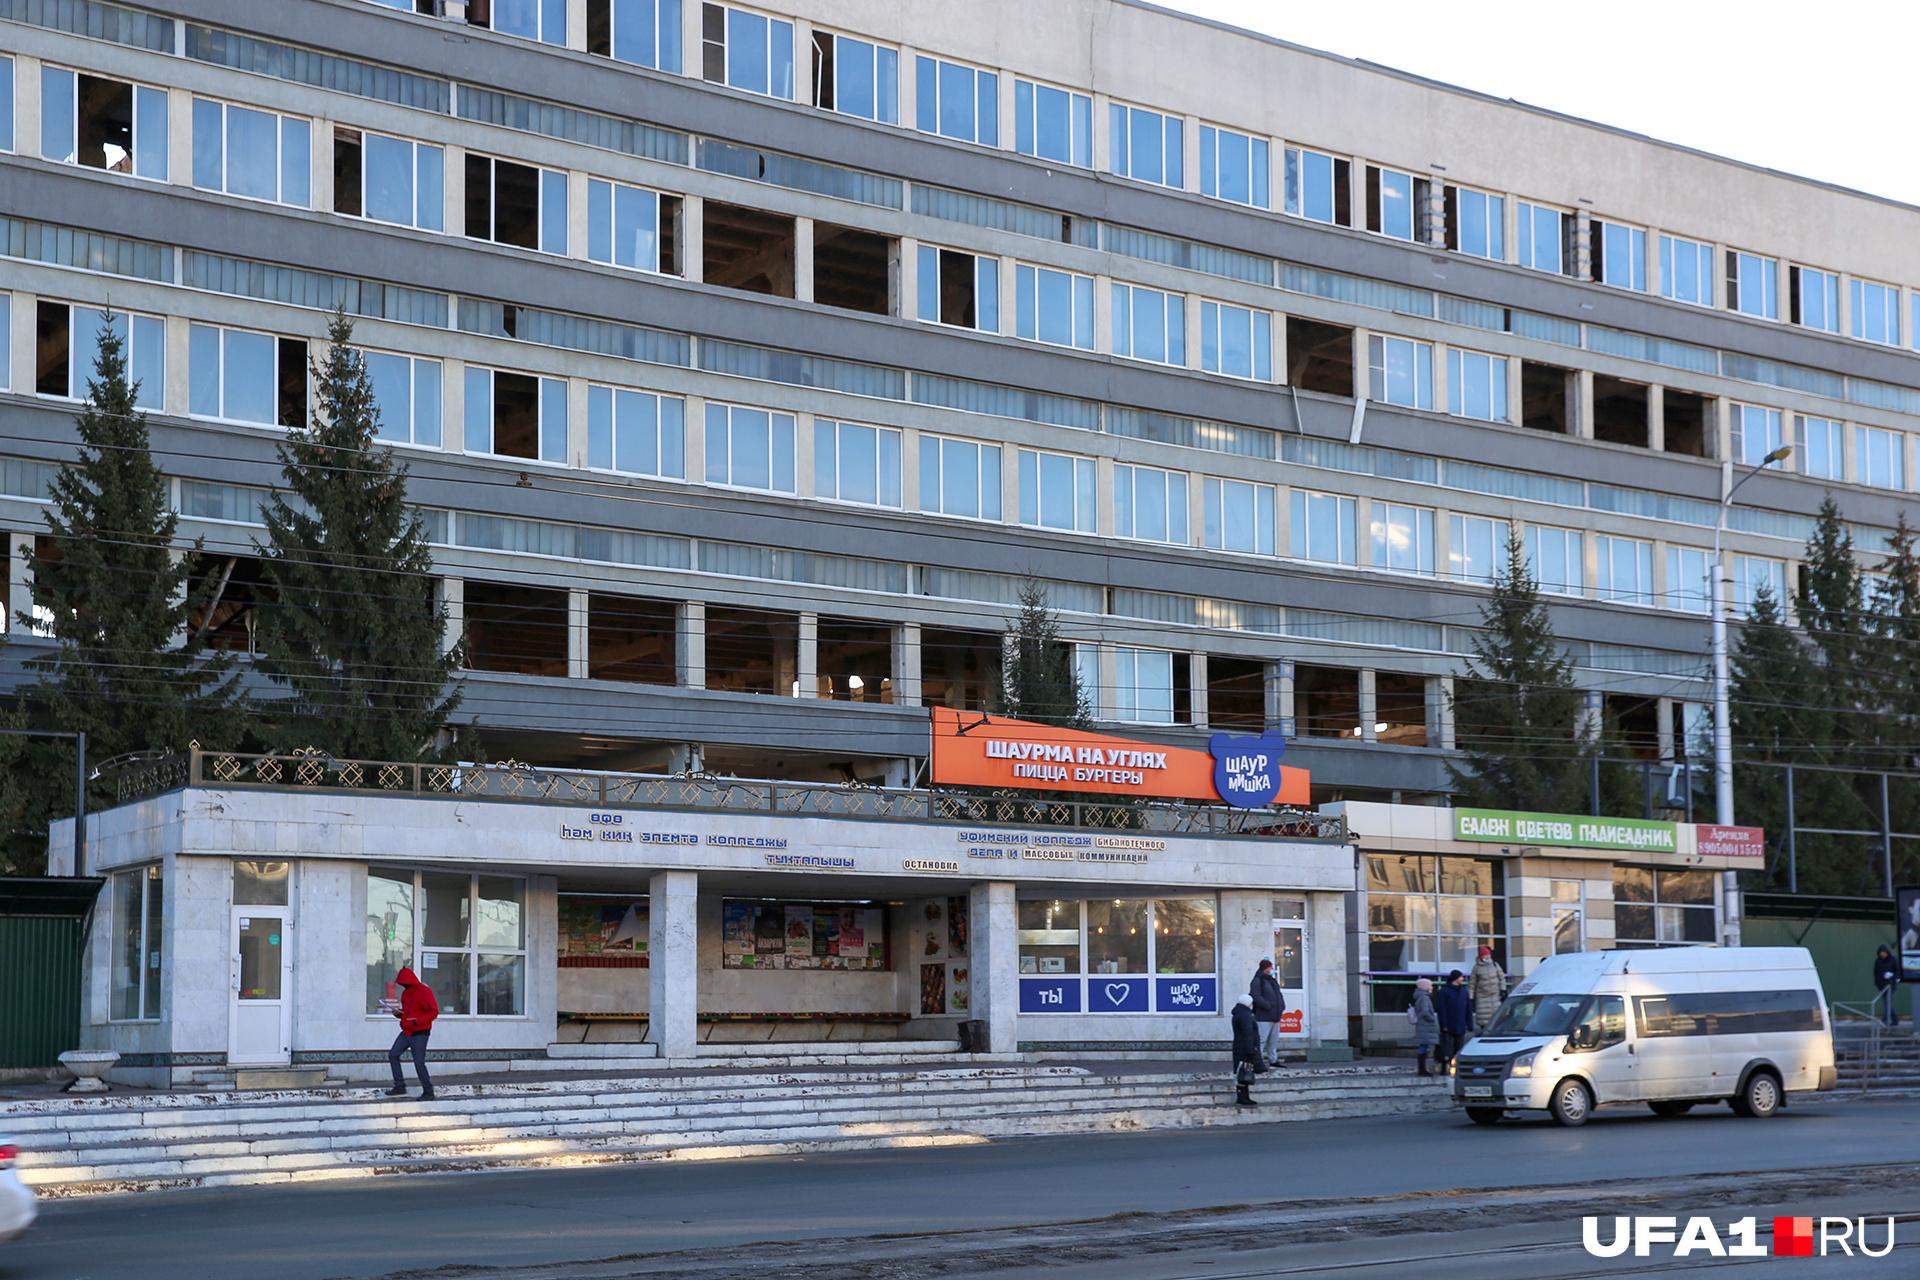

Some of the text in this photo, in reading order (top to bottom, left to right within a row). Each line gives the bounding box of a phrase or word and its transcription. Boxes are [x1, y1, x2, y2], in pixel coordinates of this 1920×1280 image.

[986, 740, 1167, 771] ШАУРМА НА УГЛЯХ
[1226, 754, 1267, 776] ШАУР
[1013, 763, 1143, 785] ПИЦЦА БУРГЕРЫ
[1228, 774, 1271, 792] МИШКА
[1460, 816, 1674, 848] САЛОН ЦВЕТОВ ПАЛИСАДНИК
[1709, 827, 1750, 841] Аренда
[707, 835, 788, 848] КОЛЛЕДЖЫ
[960, 832, 1166, 850] УФИМСКИЙ КОЛЛЕДЖ БИБЛИОТЕЧНОГО
[969, 848, 1148, 864] ДЕЛА И МАССОВЫХ КОММУНИКАЦИЙ
[904, 860, 958, 871] ОСТАНОВКА
[1039, 987, 1063, 1004] ТЫ
[1170, 983, 1199, 997] ШАУР
[1172, 994, 1203, 1006] МИШКУ
